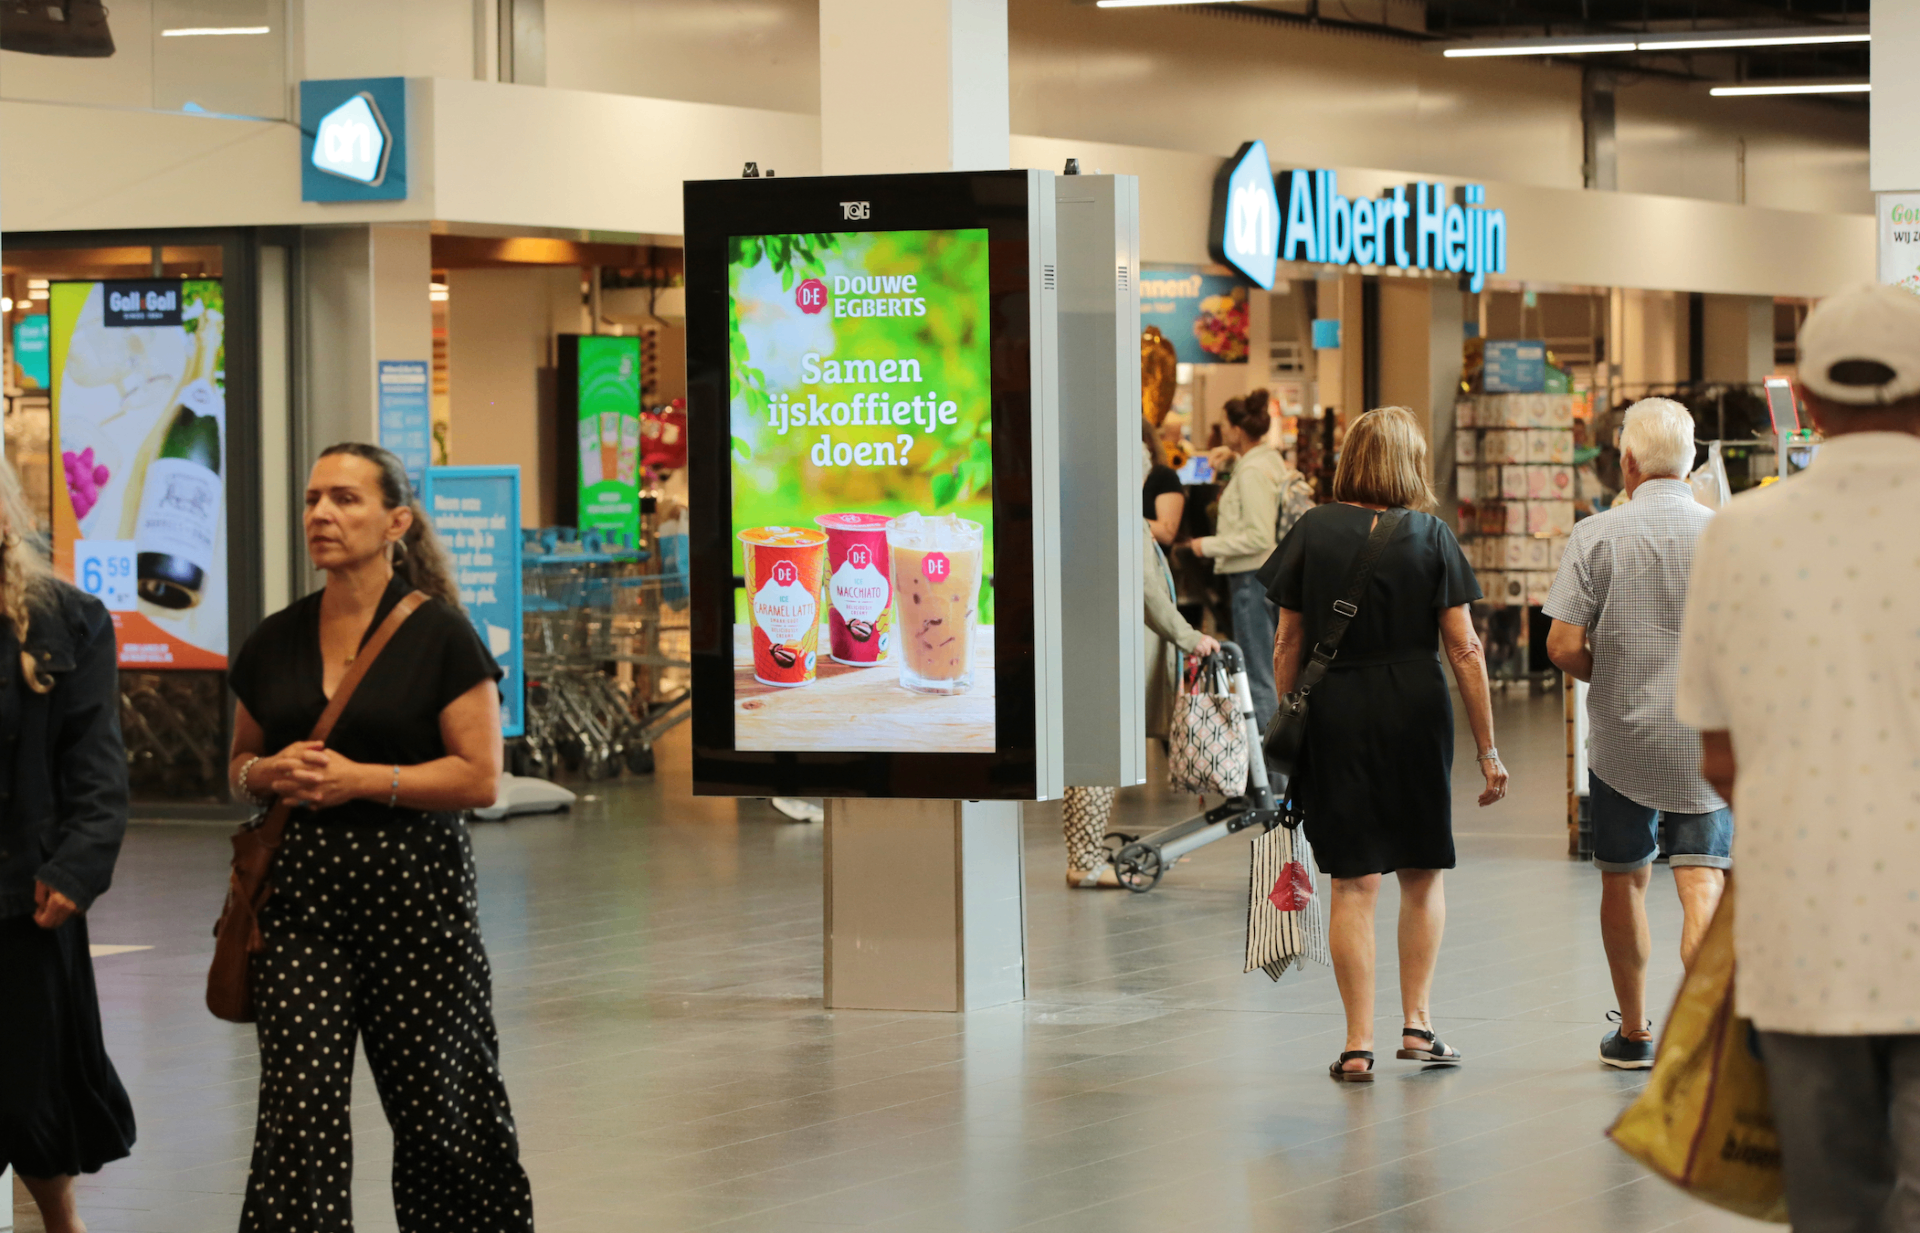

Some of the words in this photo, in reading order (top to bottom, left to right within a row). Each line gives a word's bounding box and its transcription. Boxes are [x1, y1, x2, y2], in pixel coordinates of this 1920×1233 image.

[1283, 167, 1410, 270] Albert
[1416, 181, 1507, 294] Heijn
[1893, 230, 1911, 245] WIJ
[834, 297, 927, 318] EGBERTS
[801, 352, 923, 385] Samen
[767, 391, 958, 436] ijskoffietje
[810, 433, 914, 467] doen?
[779, 595, 789, 603] ICE
[836, 585, 882, 599] MACCHIATO
[754, 601, 791, 618] CARAMEL
[792, 602, 815, 618] LATTE
